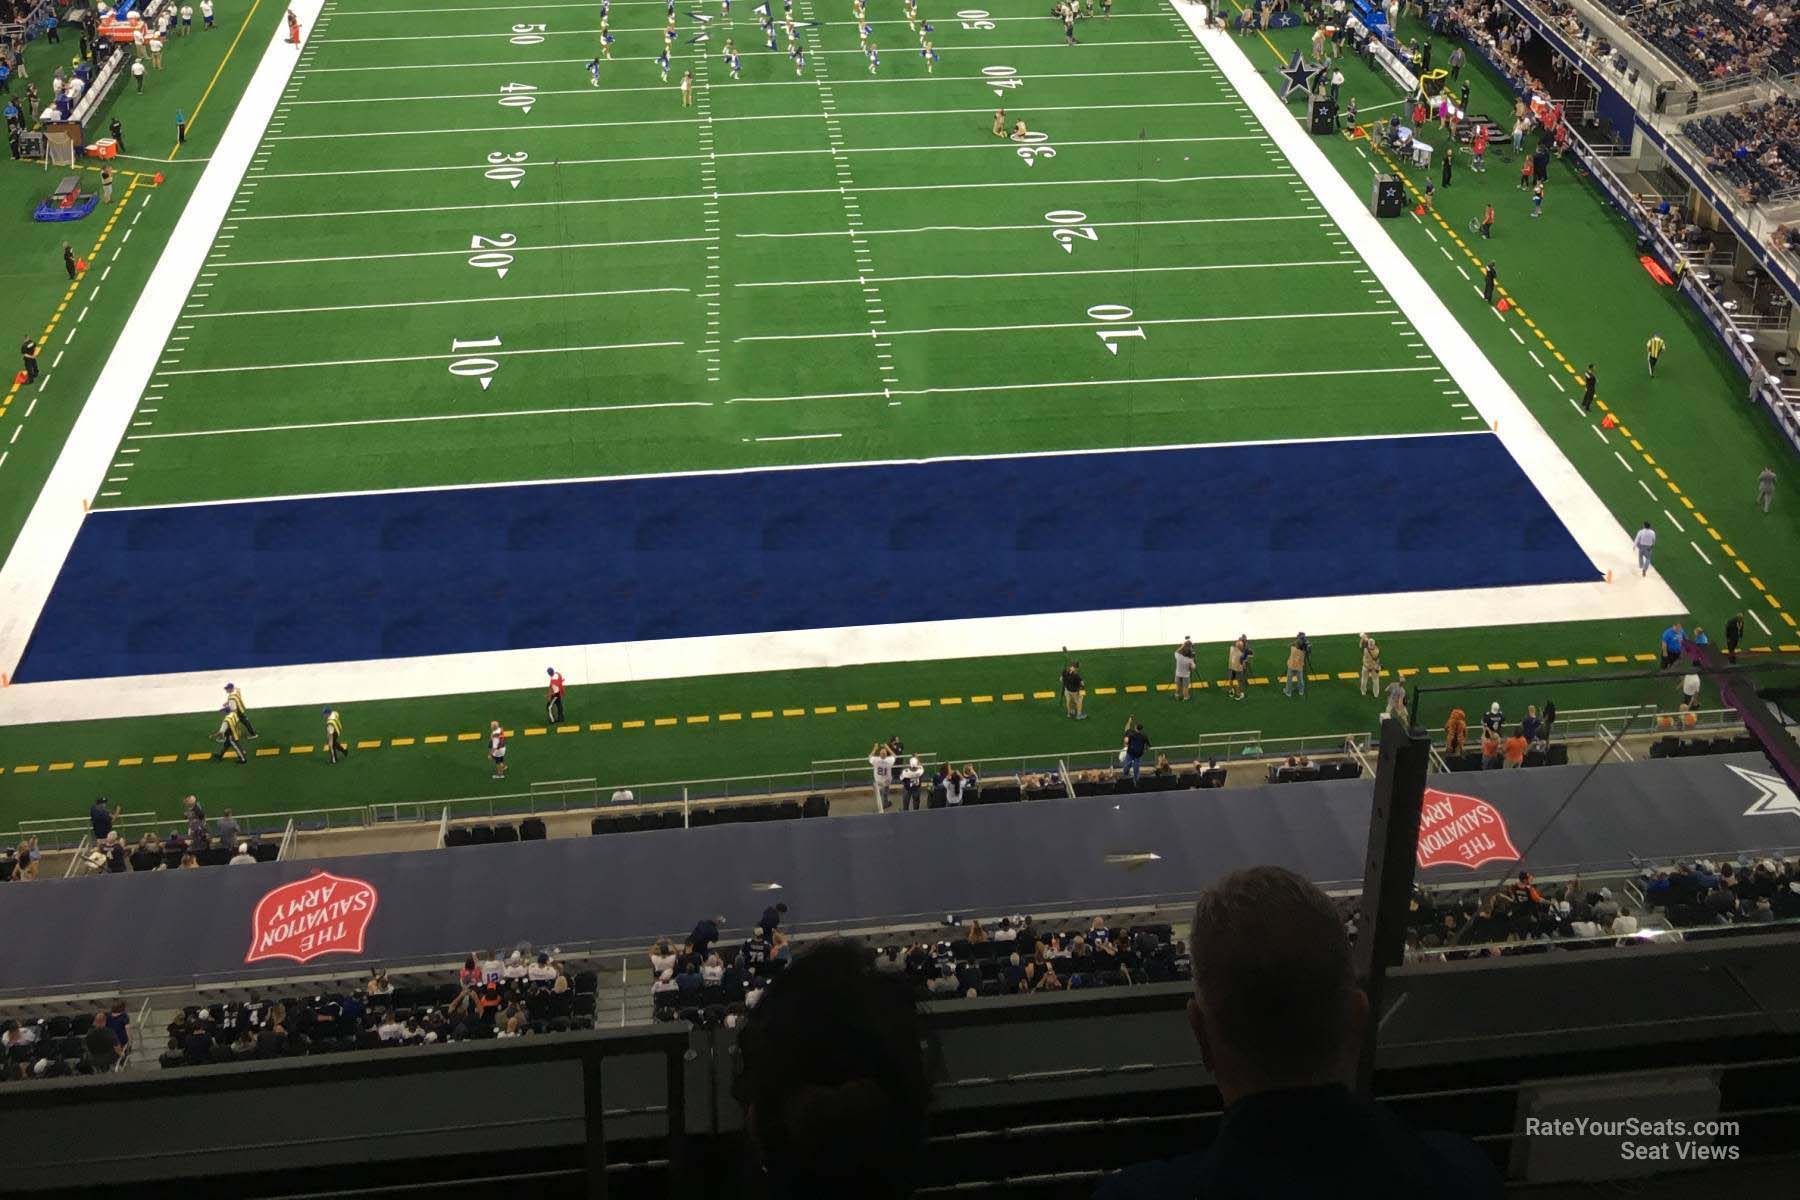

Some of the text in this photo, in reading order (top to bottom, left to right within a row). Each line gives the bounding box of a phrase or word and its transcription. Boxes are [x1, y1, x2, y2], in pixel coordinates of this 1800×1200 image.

[509, 23, 547, 44] 50
[956, 9, 996, 30] 50
[981, 65, 1024, 89] 40
[498, 82, 538, 107] 40
[1010, 131, 1057, 158] 30
[484, 151, 528, 180] 30
[1045, 210, 1099, 242] 20
[468, 233, 517, 268] 20
[1087, 304, 1147, 341] 10
[448, 335, 502, 376] 10
[1420, 796, 1454, 831] ARM
[1418, 805, 1494, 859] SALVATION
[1458, 832, 1496, 860] THE
[269, 881, 338, 926] ARMY
[260, 890, 370, 952] SALVATION
[299, 921, 348, 953] THE
